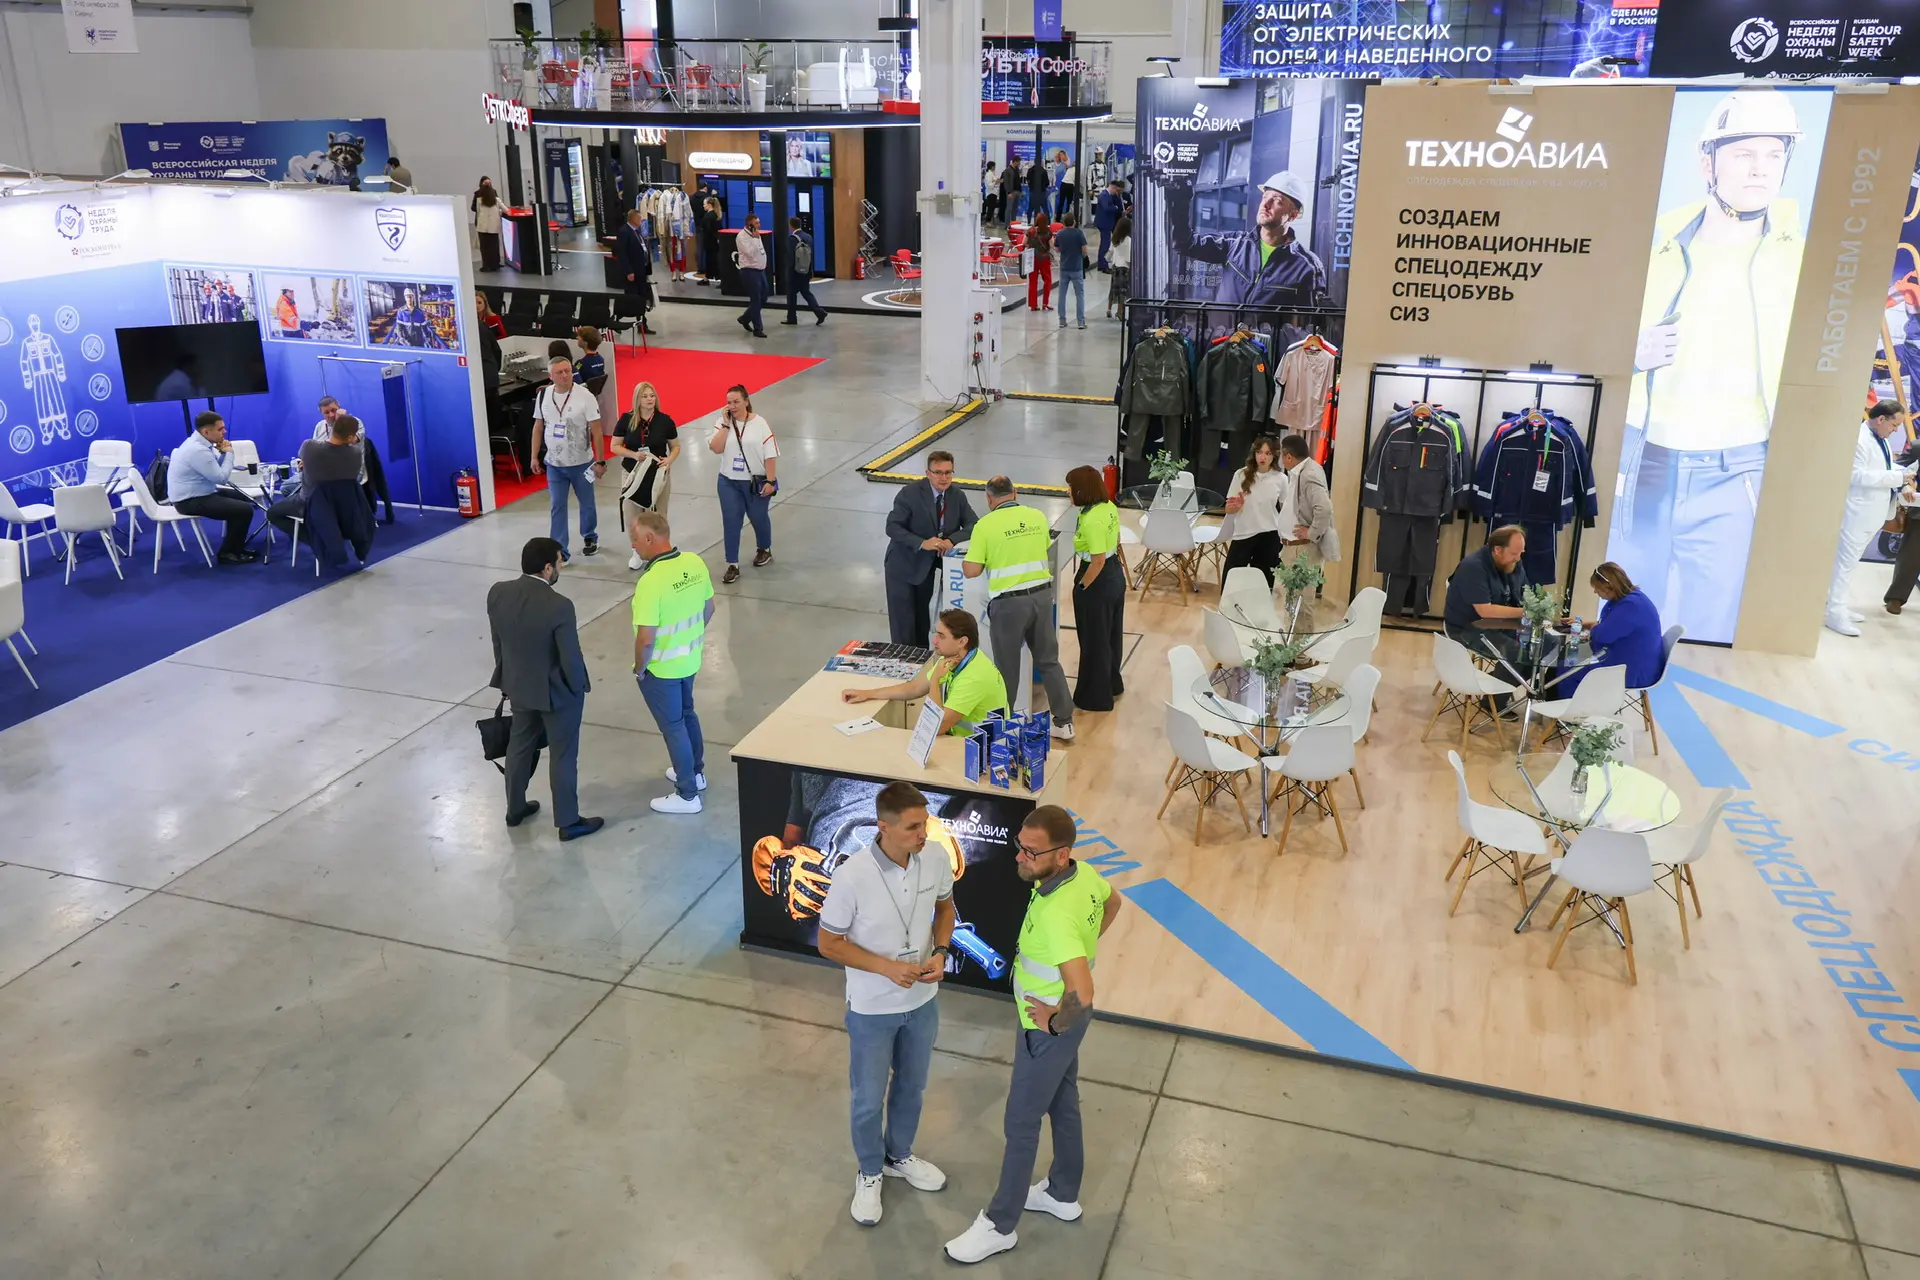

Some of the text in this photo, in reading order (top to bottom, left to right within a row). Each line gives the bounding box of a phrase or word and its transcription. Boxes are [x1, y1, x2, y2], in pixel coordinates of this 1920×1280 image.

[1255, 3, 1333, 21] ЗАЩИТА
[1611, 9, 1658, 18] СДЕЛАНО
[1254, 24, 1451, 42] ОТ ЭЛЕКТРИЧЕСКИХ
[1788, 26, 1836, 37] НЕДЕЛЯ
[1850, 26, 1902, 36] LABOUR
[1786, 38, 1836, 47] ОХРАНЫ
[1849, 37, 1896, 46] SAFETY
[1252, 46, 1492, 65] ПОЛЕЙ И НАВЕДЕННОГО
[1785, 48, 1824, 58] ТРУДА
[1848, 48, 1882, 57] WEEK
[997, 56, 1088, 76] БТКСфера
[1155, 118, 1240, 131] ТЕХНОАВИА
[1406, 140, 1608, 169] ТЕХНОАВИА
[152, 158, 278, 169] ВСЕРОССИЙСКАЯ НЕДЕЛЯ
[198, 169, 226, 178] ТРУД
[1333, 103, 1363, 272] TECHNOAVIA.RU
[88, 208, 116, 217] НЕДЕЛЯ
[1399, 208, 1500, 229] СОЗДАЕМ
[90, 216, 118, 226] ОХРАНЫ
[92, 226, 115, 234] ТРУДА
[1396, 233, 1592, 254] ИННОВАЦИОННЫЕ
[1816, 147, 1880, 372] РАБОТАЕМ С 1992
[1394, 257, 1543, 281] СПЕЦОДЕЖДУ
[1172, 274, 1222, 287] МАСТЕР
[1392, 282, 1514, 302] СПЕЦОБУВЬ
[1389, 306, 1430, 322] СИЗ
[940, 818, 1008, 838] ТЕХНОАВИА
[1722, 800, 1920, 1052] СПЕЦОДЕЖДА
